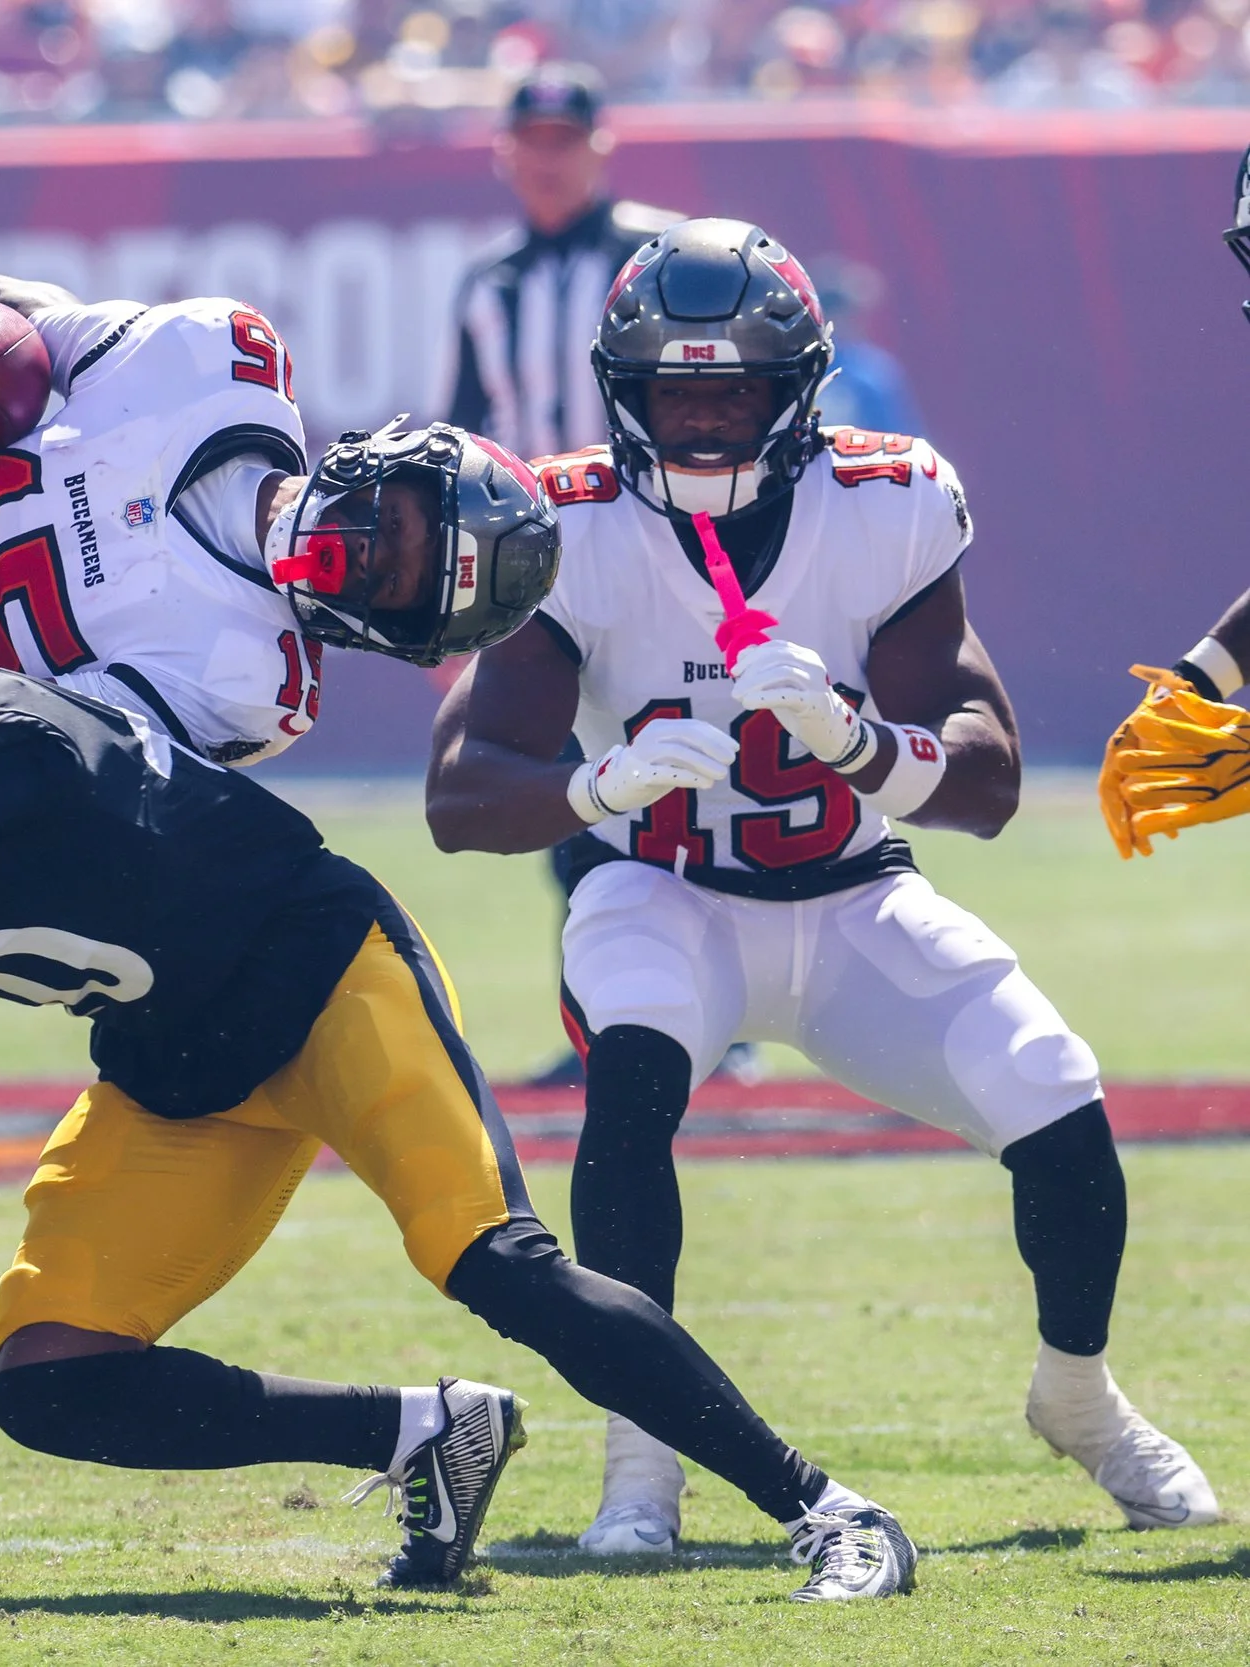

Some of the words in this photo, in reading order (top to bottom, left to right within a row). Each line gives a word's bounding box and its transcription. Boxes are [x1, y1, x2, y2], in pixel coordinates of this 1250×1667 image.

[63, 470, 105, 588] BUCCANEERS
[127, 502, 143, 525] NFL
[624, 682, 866, 871] 19
